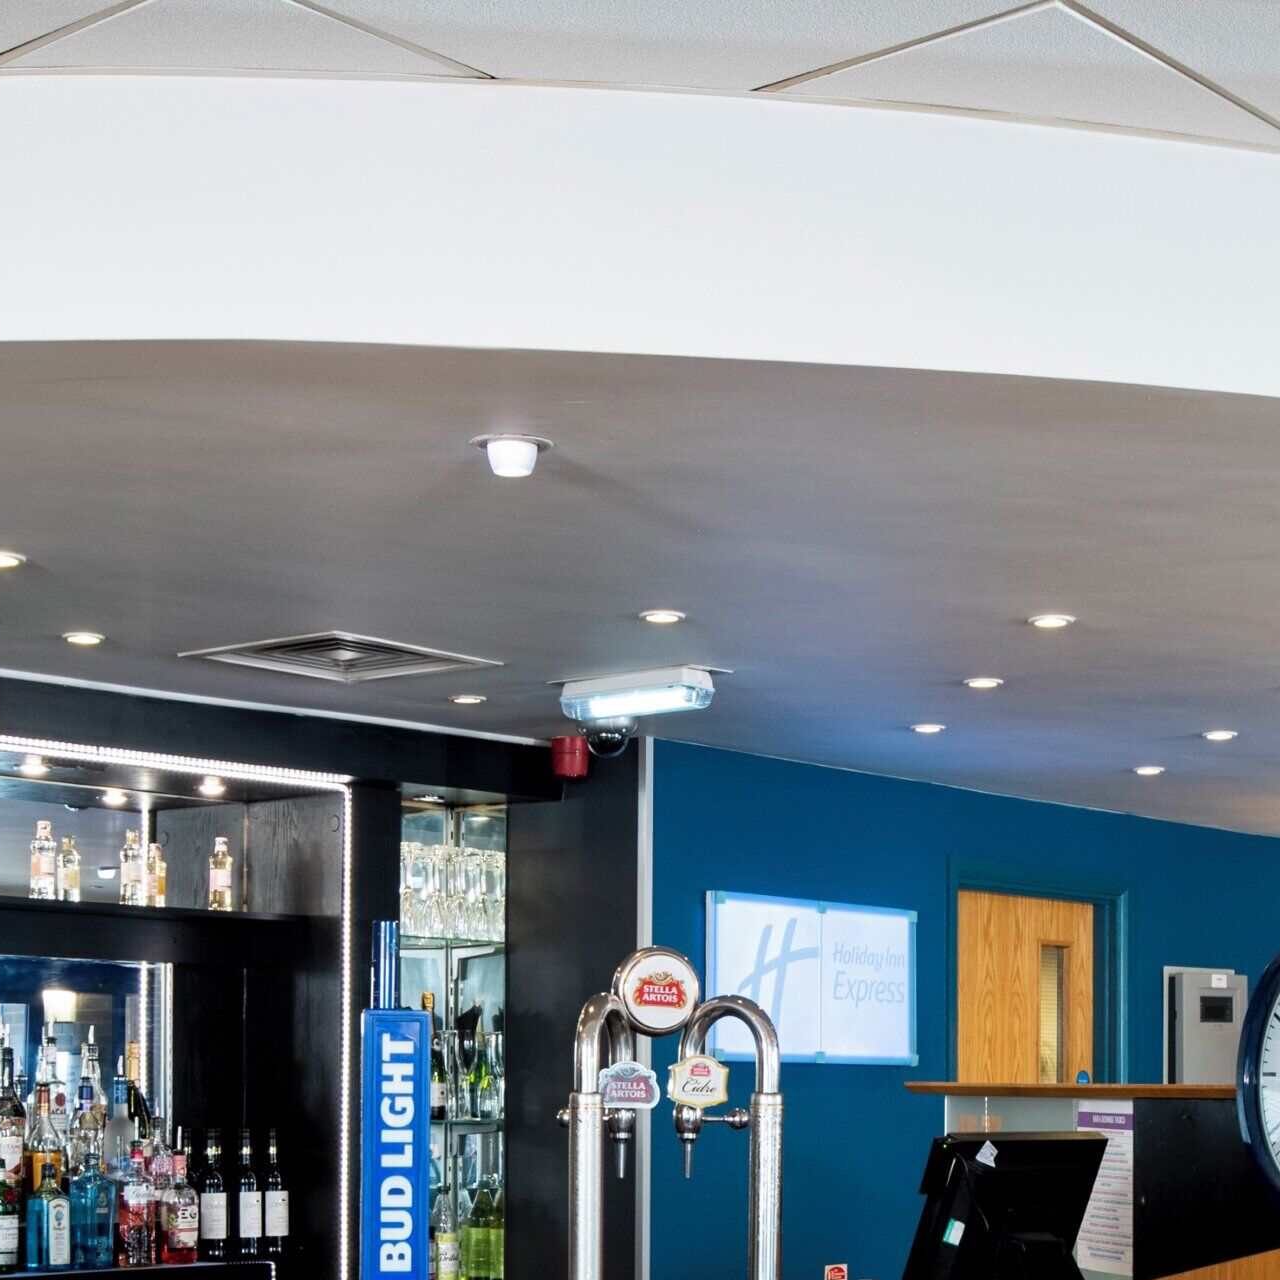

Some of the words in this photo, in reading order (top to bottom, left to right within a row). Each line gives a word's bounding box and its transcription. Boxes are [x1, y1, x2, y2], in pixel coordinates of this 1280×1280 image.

[832, 942, 884, 972] Holiday
[885, 946, 905, 968] Inn
[643, 984, 678, 995] STELLA
[833, 971, 905, 1010] Express
[642, 993, 678, 1003] ARTOIS
[609, 1089, 647, 1099] ARTOIS
[610, 1081, 646, 1091] STELLA
[682, 1078, 717, 1094] Cidre
[380, 1032, 415, 1168] LIGHT
[379, 1174, 414, 1272] BUD
